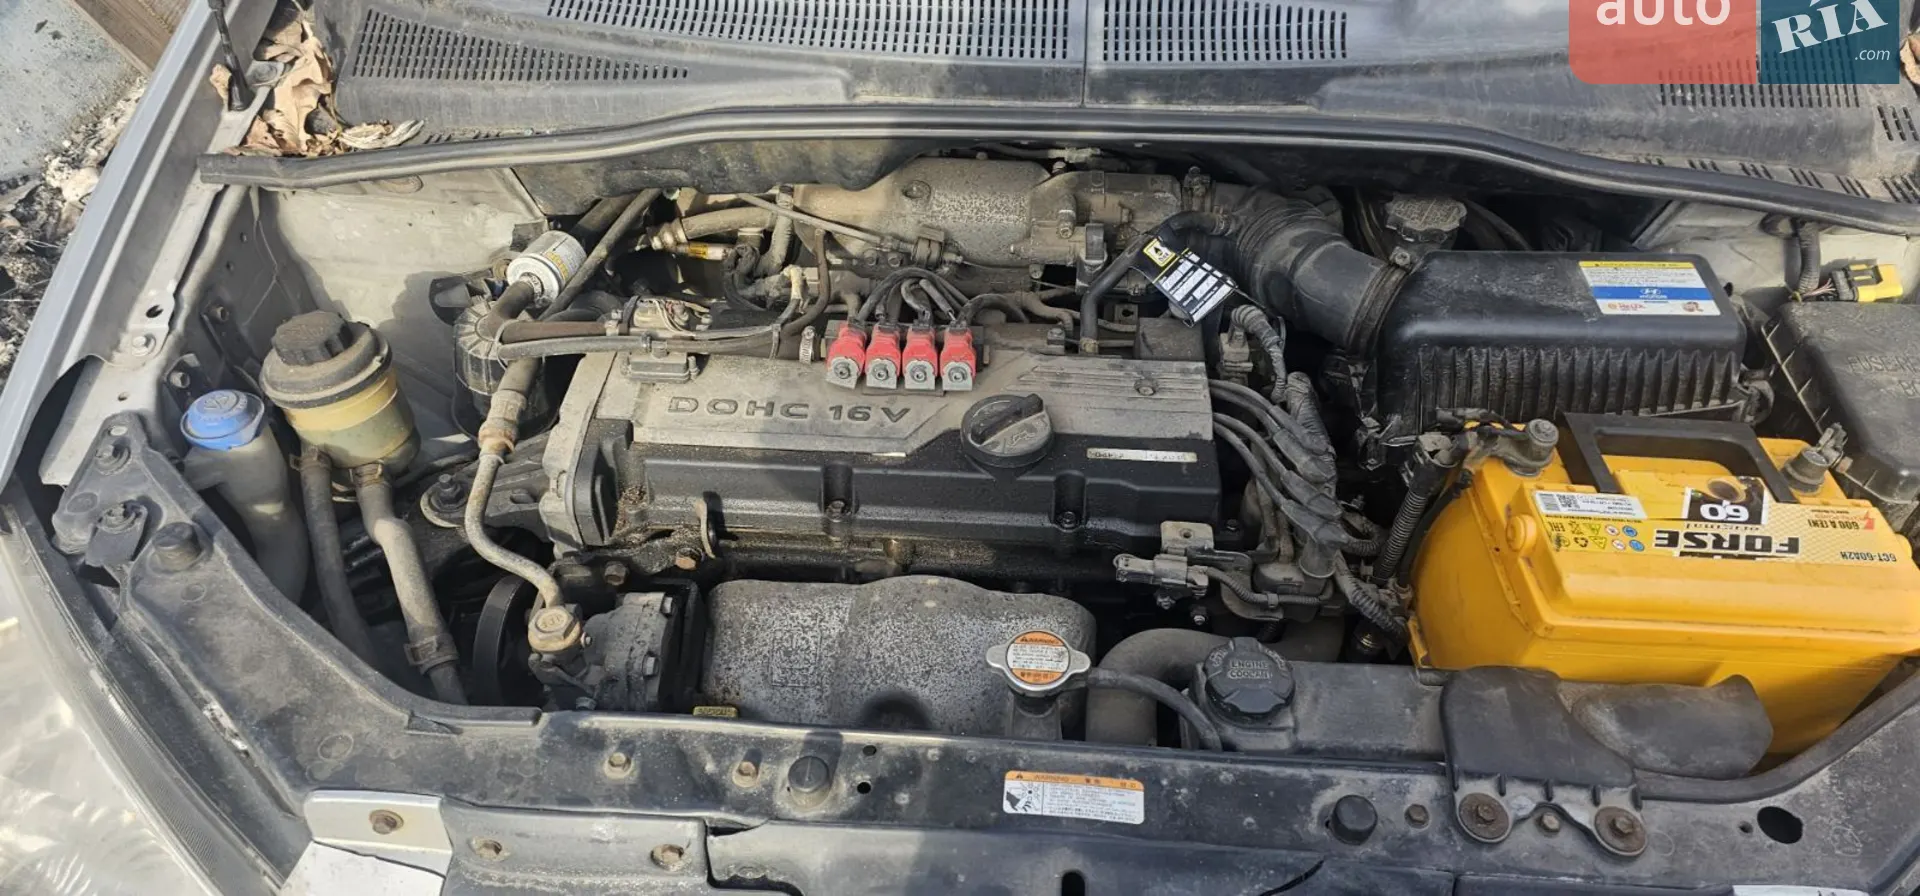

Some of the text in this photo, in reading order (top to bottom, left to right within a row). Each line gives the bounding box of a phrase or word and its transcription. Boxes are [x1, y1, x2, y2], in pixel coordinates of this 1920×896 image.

[667, 396, 911, 423] DOHC 16V
[1699, 502, 1750, 523] 60
[1654, 529, 1799, 554] FORSE
